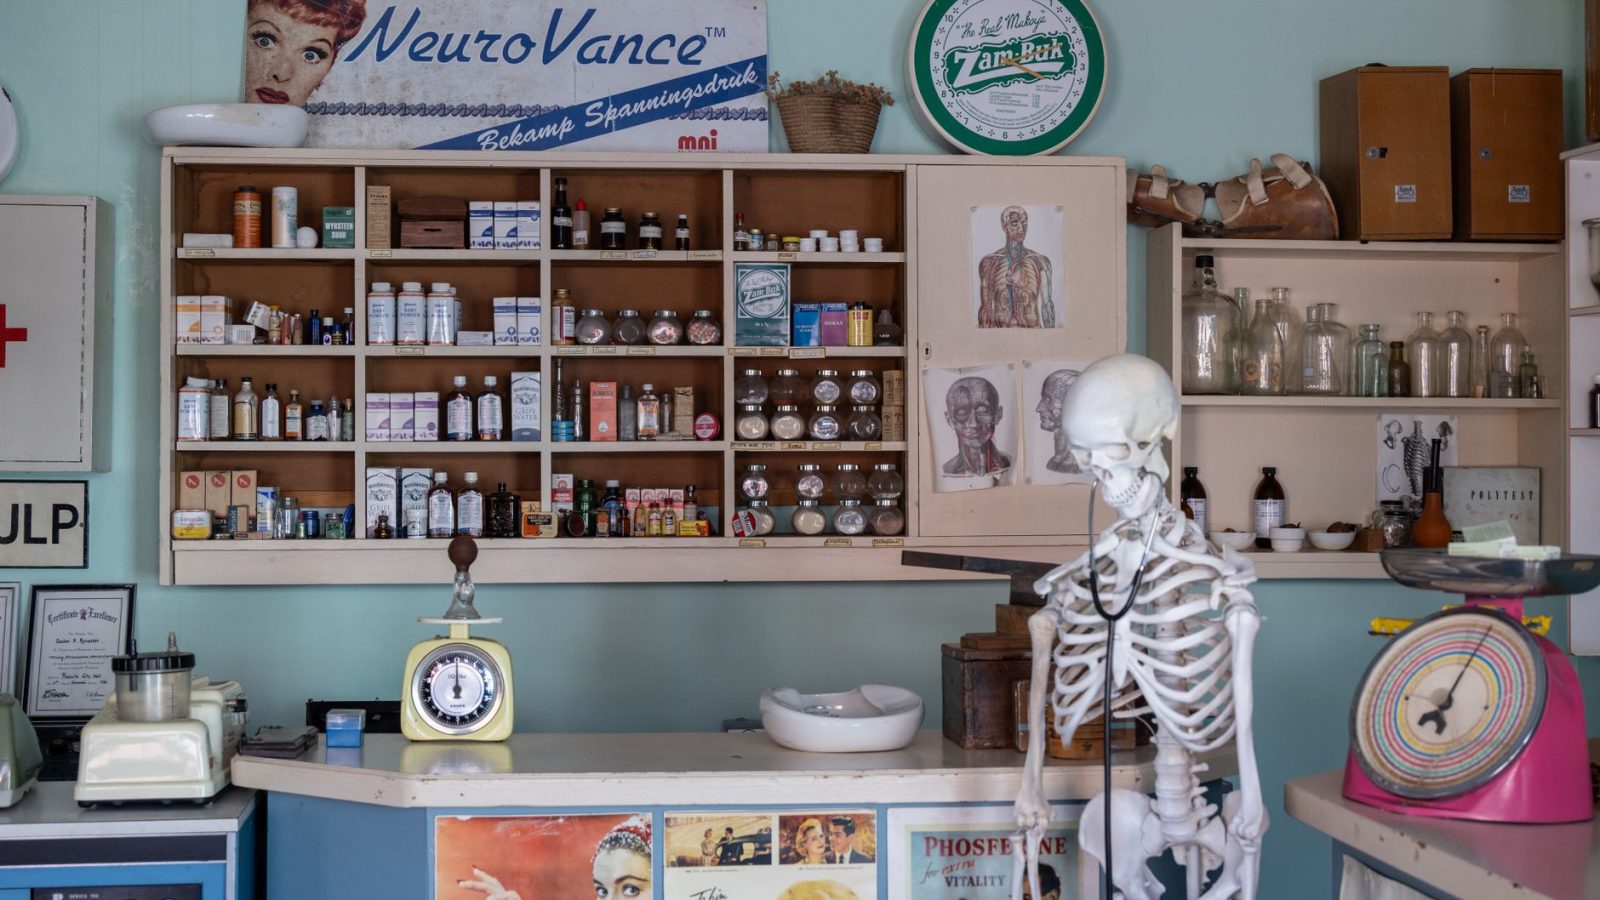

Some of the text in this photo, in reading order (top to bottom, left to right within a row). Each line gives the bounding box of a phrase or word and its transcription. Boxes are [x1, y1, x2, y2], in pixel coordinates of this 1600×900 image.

[945, 14, 954, 23] 10
[979, 18, 1003, 37] Real
[1071, 26, 1077, 34] 2
[343, 6, 707, 66] NeuroVance
[934, 52, 940, 60] 9
[1080, 63, 1086, 71] 3
[941, 90, 947, 98] 8
[477, 62, 759, 151] Bekamp Spanningsdruk
[1067, 101, 1073, 110] 4
[964, 117, 969, 126] 7
[1039, 124, 1046, 133] 5
[678, 129, 718, 150] mni
[1002, 131, 1008, 140] 6
[1471, 490, 1534, 500] POLYTEST
[924, 836, 1067, 857] PHOSFENE
[921, 859, 975, 884] for extra
[944, 875, 1005, 888] VITALITY
